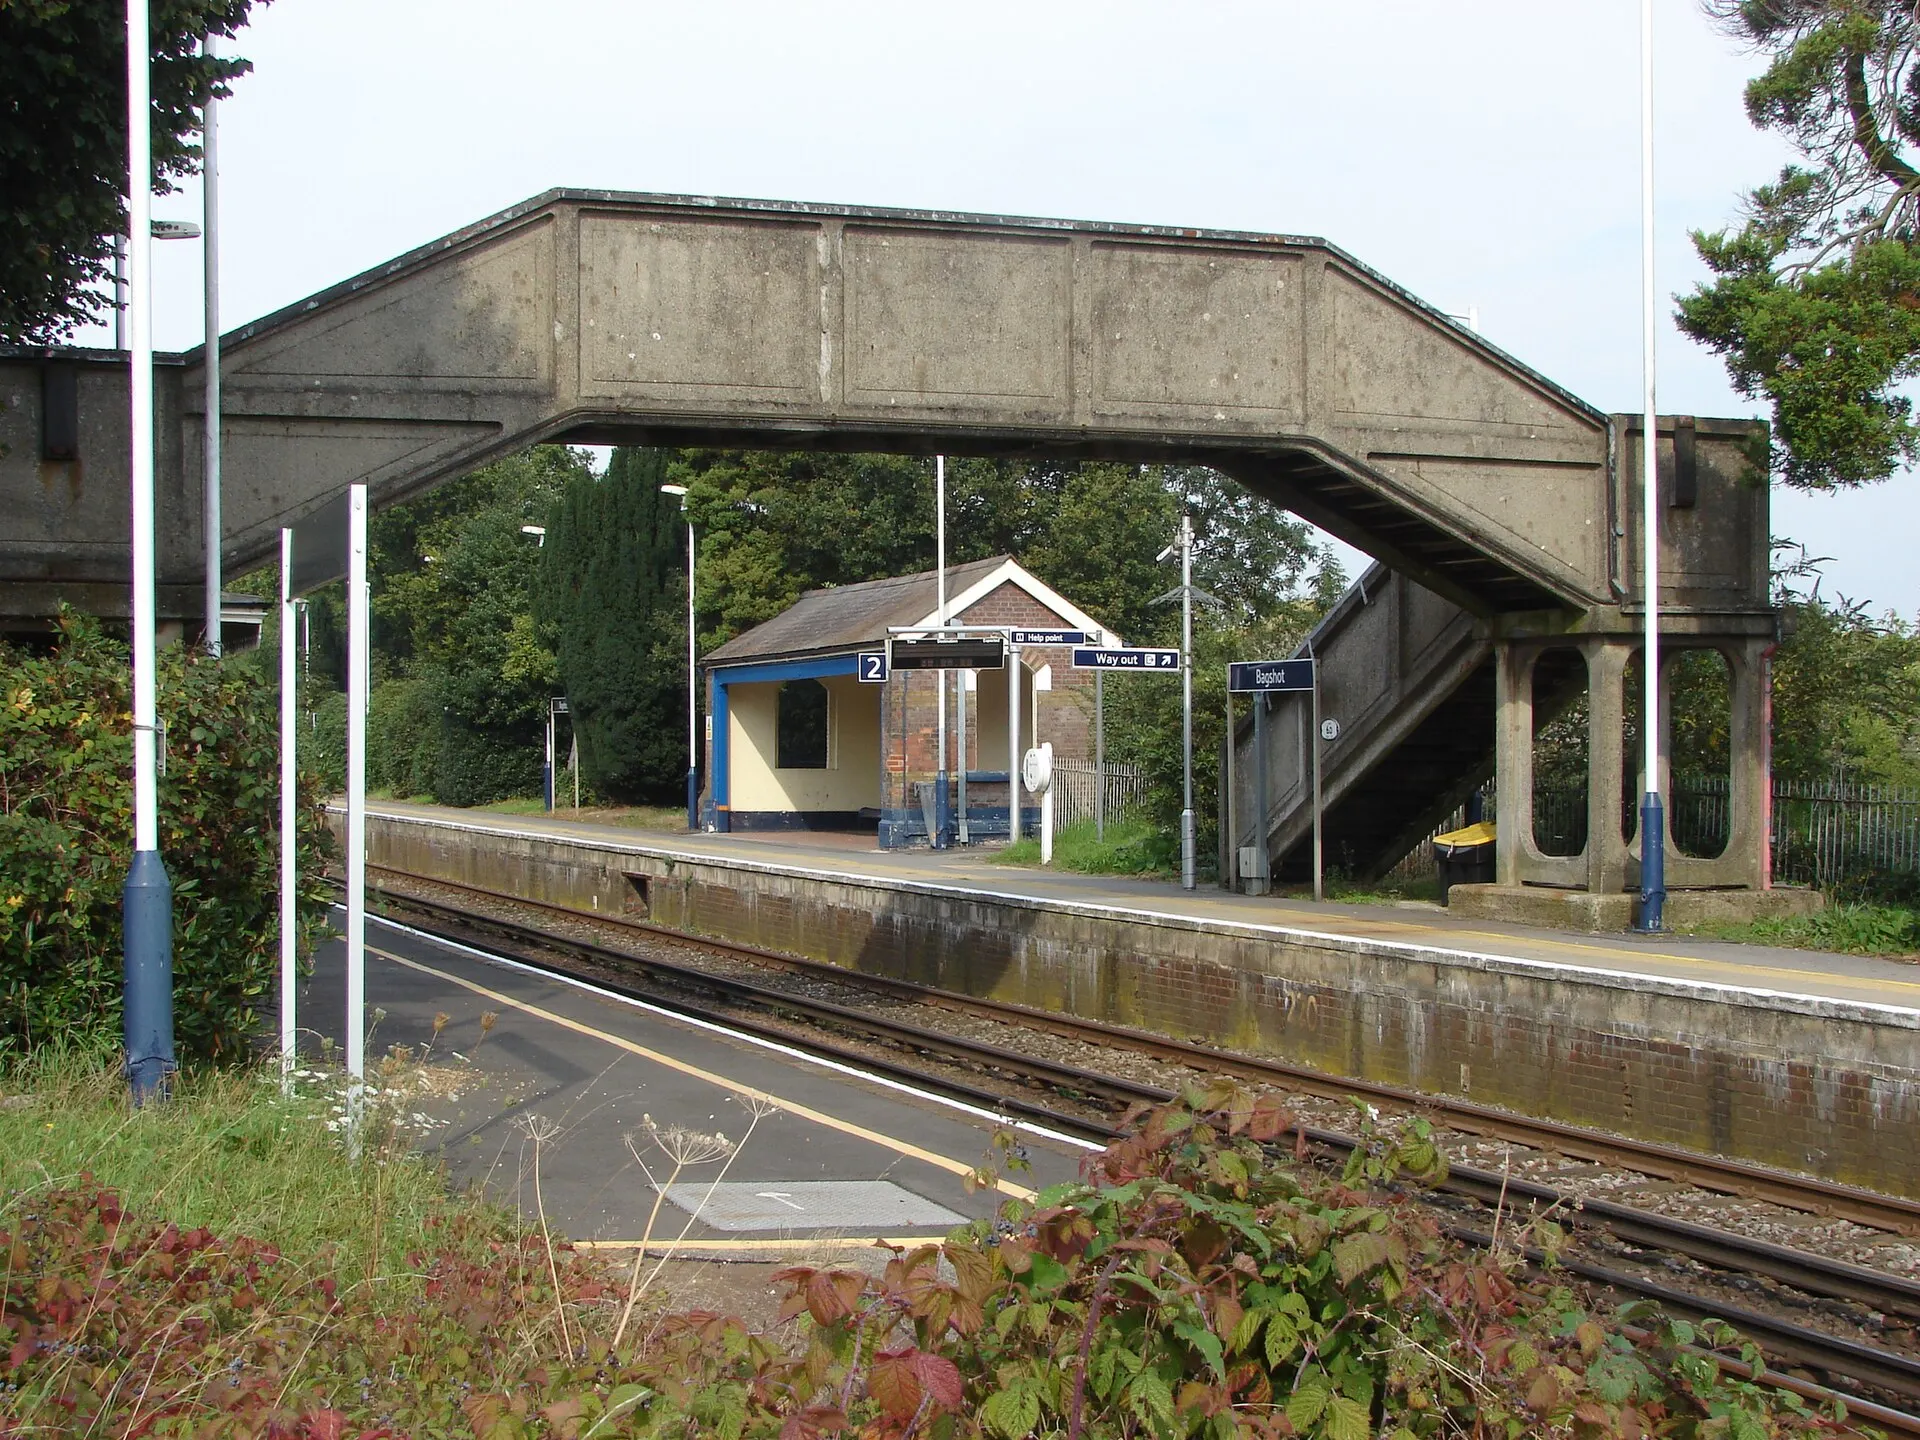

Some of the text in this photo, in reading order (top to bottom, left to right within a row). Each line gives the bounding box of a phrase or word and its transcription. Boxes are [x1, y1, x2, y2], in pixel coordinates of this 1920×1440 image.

[1027, 633, 1063, 643] Help point
[867, 656, 881, 679] 2
[1095, 653, 1138, 666] Way out
[1256, 668, 1286, 688] Bagshot
